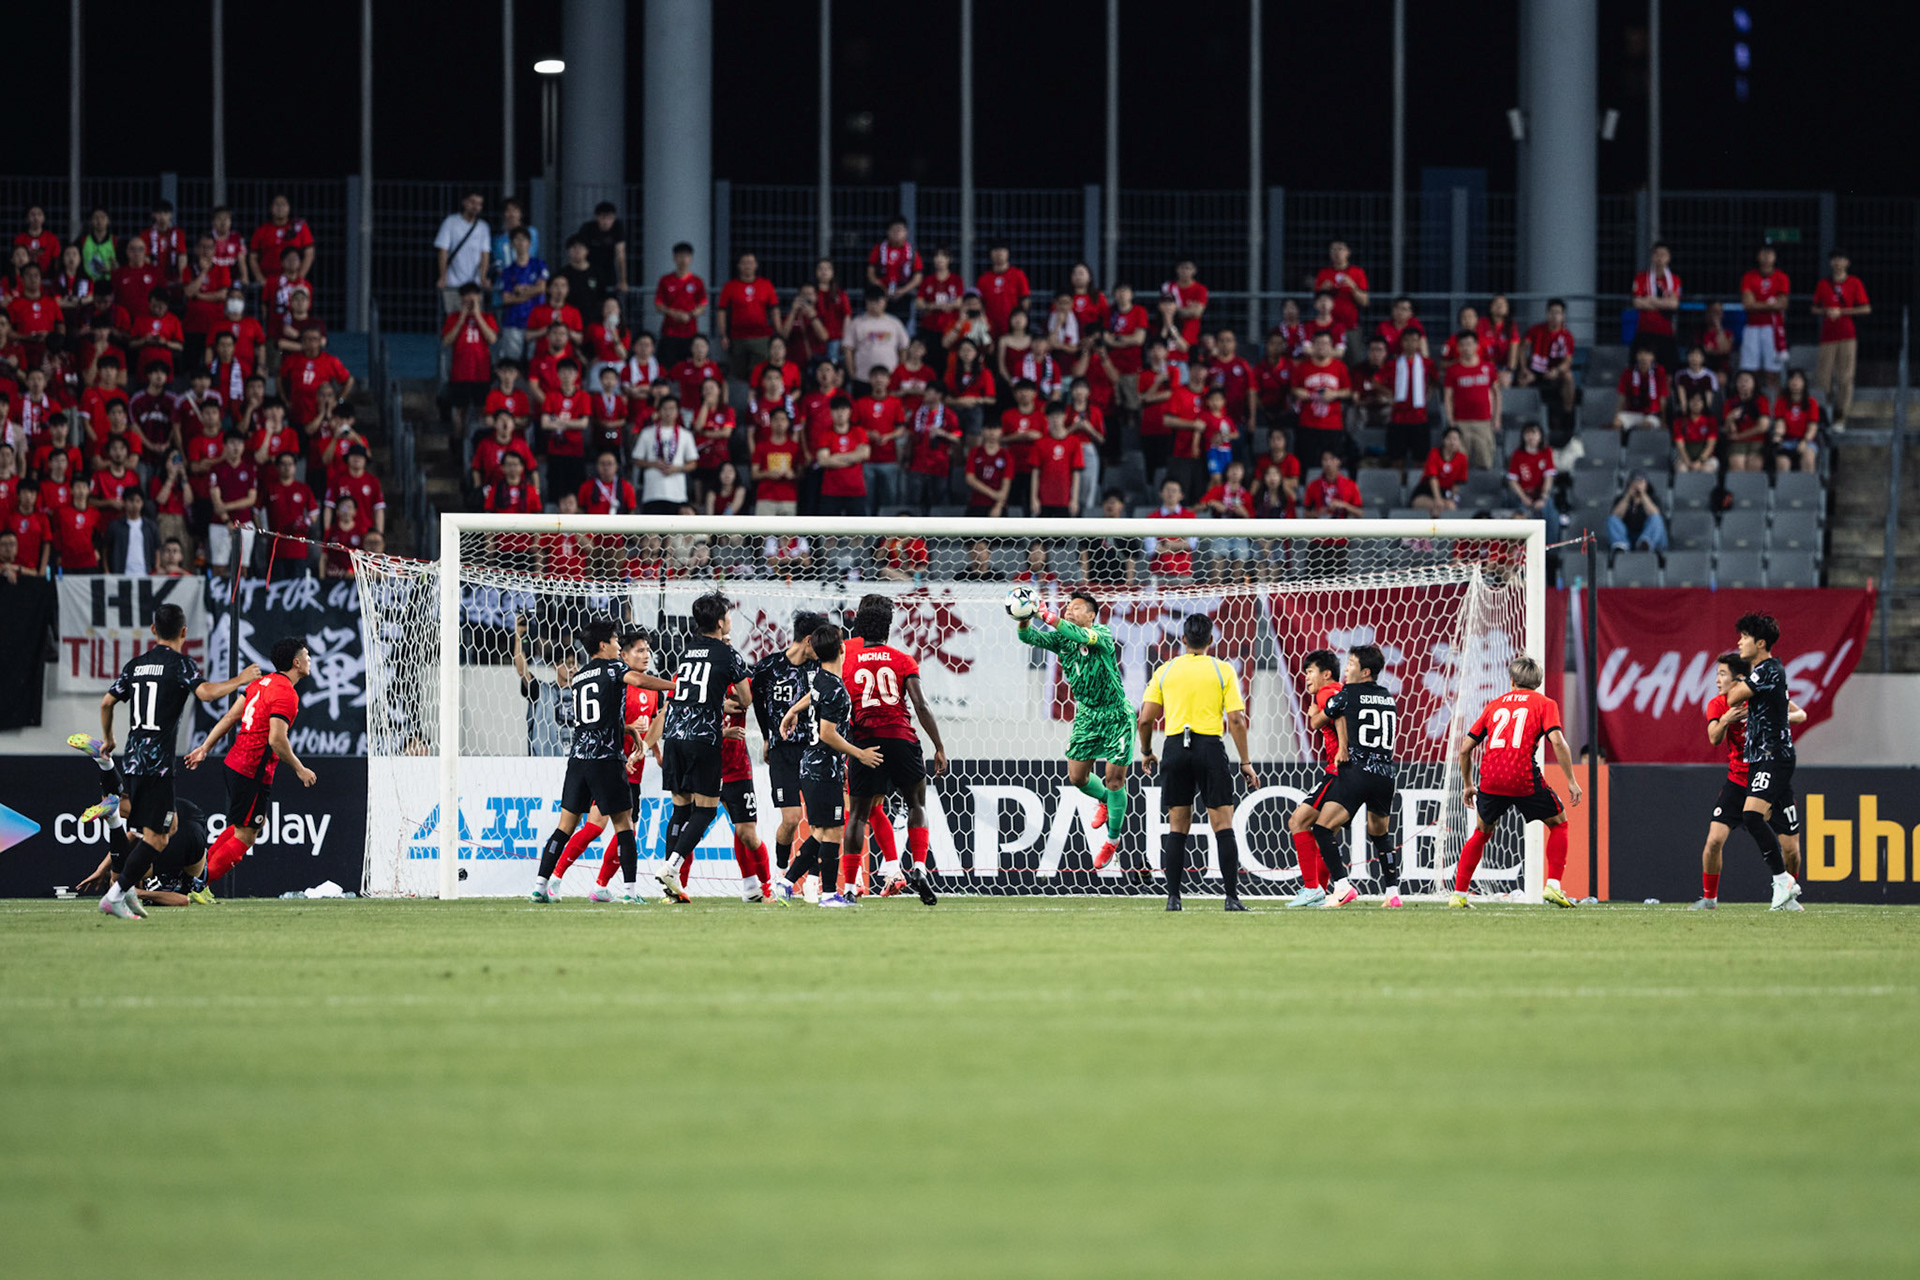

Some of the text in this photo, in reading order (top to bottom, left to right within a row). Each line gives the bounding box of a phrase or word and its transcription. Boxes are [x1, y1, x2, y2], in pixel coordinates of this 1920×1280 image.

[90, 578, 182, 628] HK
[857, 651, 892, 663] MICHAEL
[572, 681, 600, 727] 16
[674, 661, 712, 704] 24
[773, 685, 793, 702] 23
[854, 666, 901, 709] 20
[131, 681, 161, 731] 11
[241, 690, 260, 731] 4
[1358, 708, 1397, 750] 20
[1490, 707, 1529, 750] 21
[1751, 771, 1771, 789] 26
[877, 785, 1123, 878] APA
[1783, 804, 1798, 824] 17
[1806, 793, 1920, 882] bh
